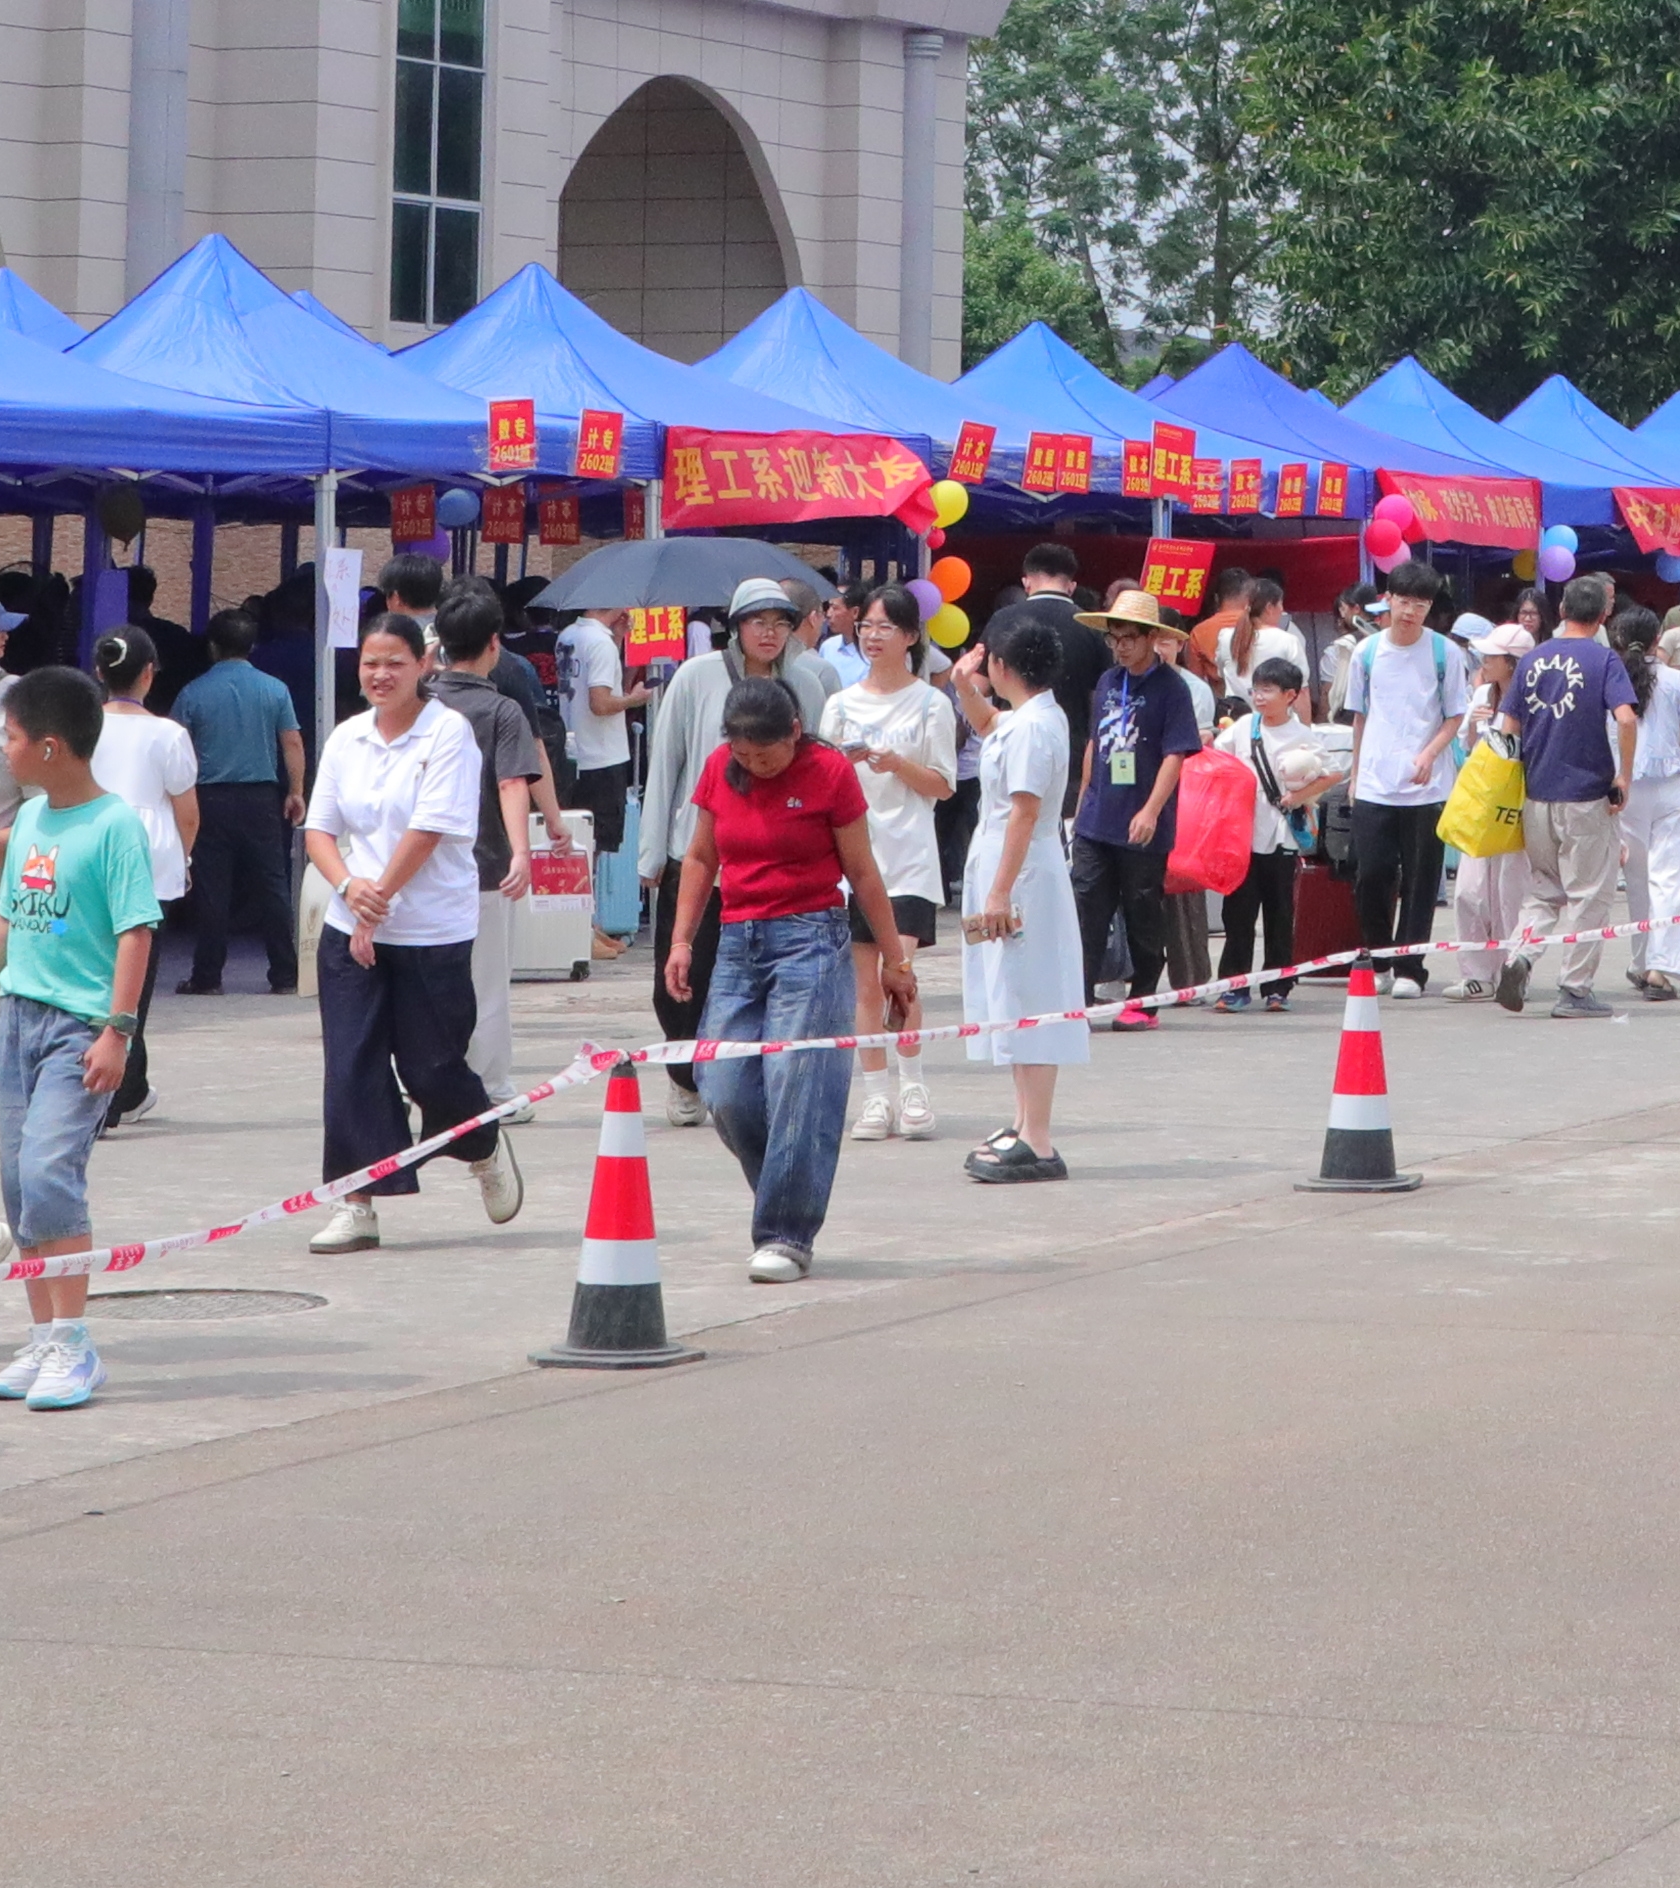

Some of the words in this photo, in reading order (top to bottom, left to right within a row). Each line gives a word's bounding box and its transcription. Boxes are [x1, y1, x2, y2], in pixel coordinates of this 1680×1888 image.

[1152, 447, 1193, 486] 理工系
[1143, 564, 1206, 600] 理工系
[628, 605, 685, 645] 理工系
[1525, 653, 1585, 689] CRANK
[1524, 692, 1548, 715] IT
[1550, 691, 1577, 720] UP
